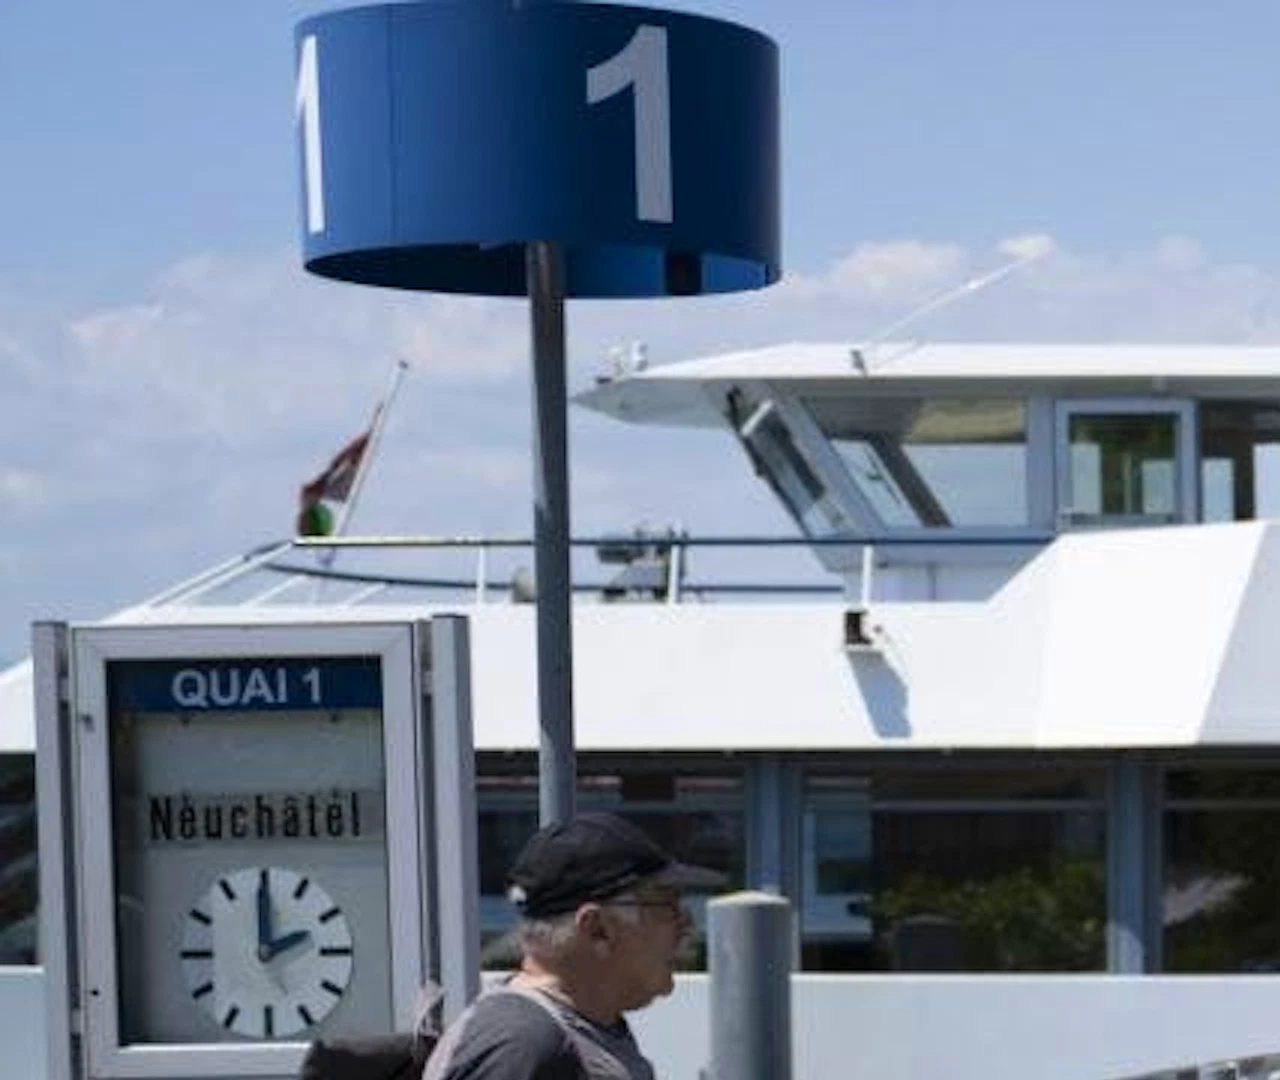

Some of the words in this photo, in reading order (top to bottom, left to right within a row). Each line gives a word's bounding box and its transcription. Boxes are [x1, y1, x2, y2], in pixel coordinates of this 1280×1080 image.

[295, 34, 326, 237] 1
[586, 25, 674, 224] 1
[172, 668, 288, 706] QUAI
[303, 669, 324, 704] 1
